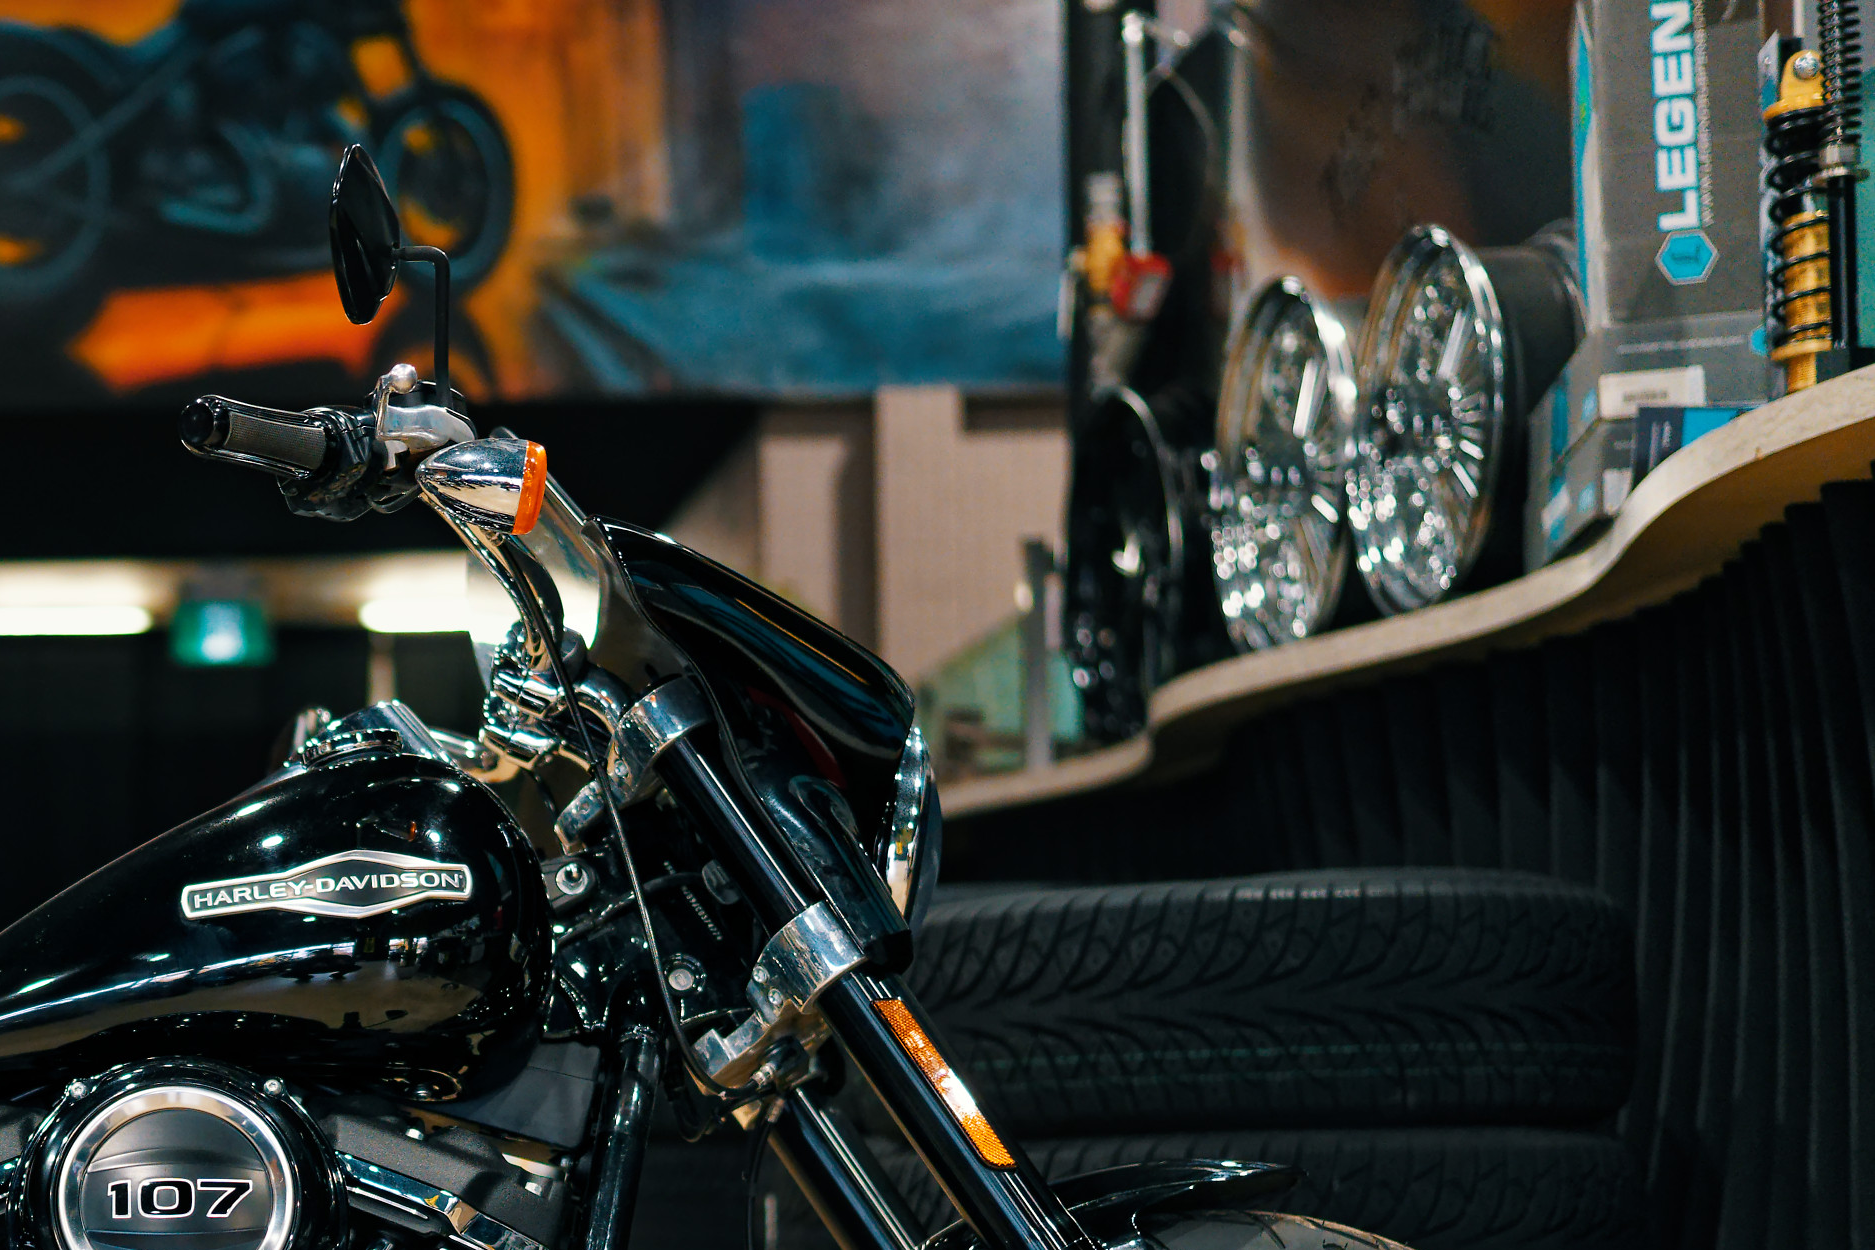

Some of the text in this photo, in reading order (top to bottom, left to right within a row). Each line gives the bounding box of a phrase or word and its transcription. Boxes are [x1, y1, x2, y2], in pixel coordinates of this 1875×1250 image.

[1649, 0, 1702, 232] LEGEN
[193, 871, 461, 909] HARLEY-DAVIDSON
[107, 1177, 253, 1219] 107
